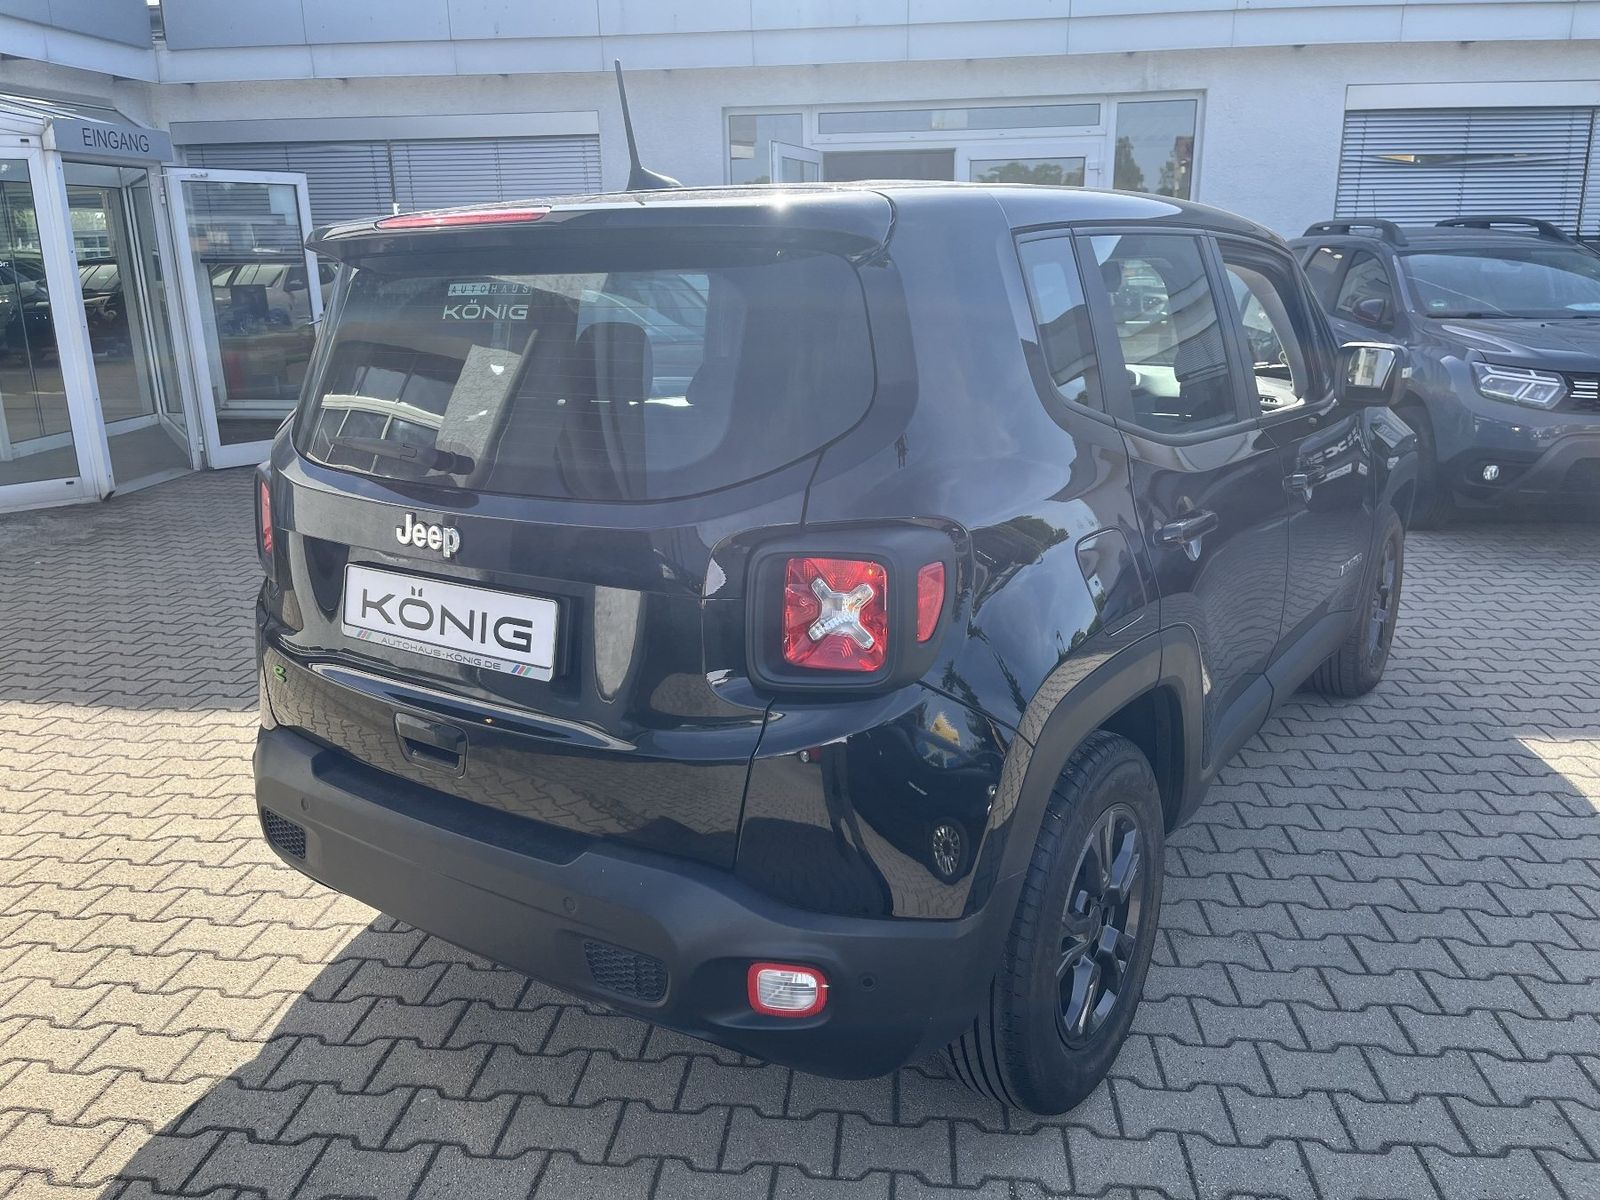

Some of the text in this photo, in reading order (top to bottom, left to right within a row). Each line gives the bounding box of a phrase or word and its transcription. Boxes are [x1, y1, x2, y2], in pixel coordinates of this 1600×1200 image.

[82, 128, 150, 153] EINGANG
[449, 283, 530, 295] AUTOHAUS
[442, 299, 529, 320] KÖNIG
[395, 512, 460, 558] Jeep
[361, 586, 534, 653] KÖNIG
